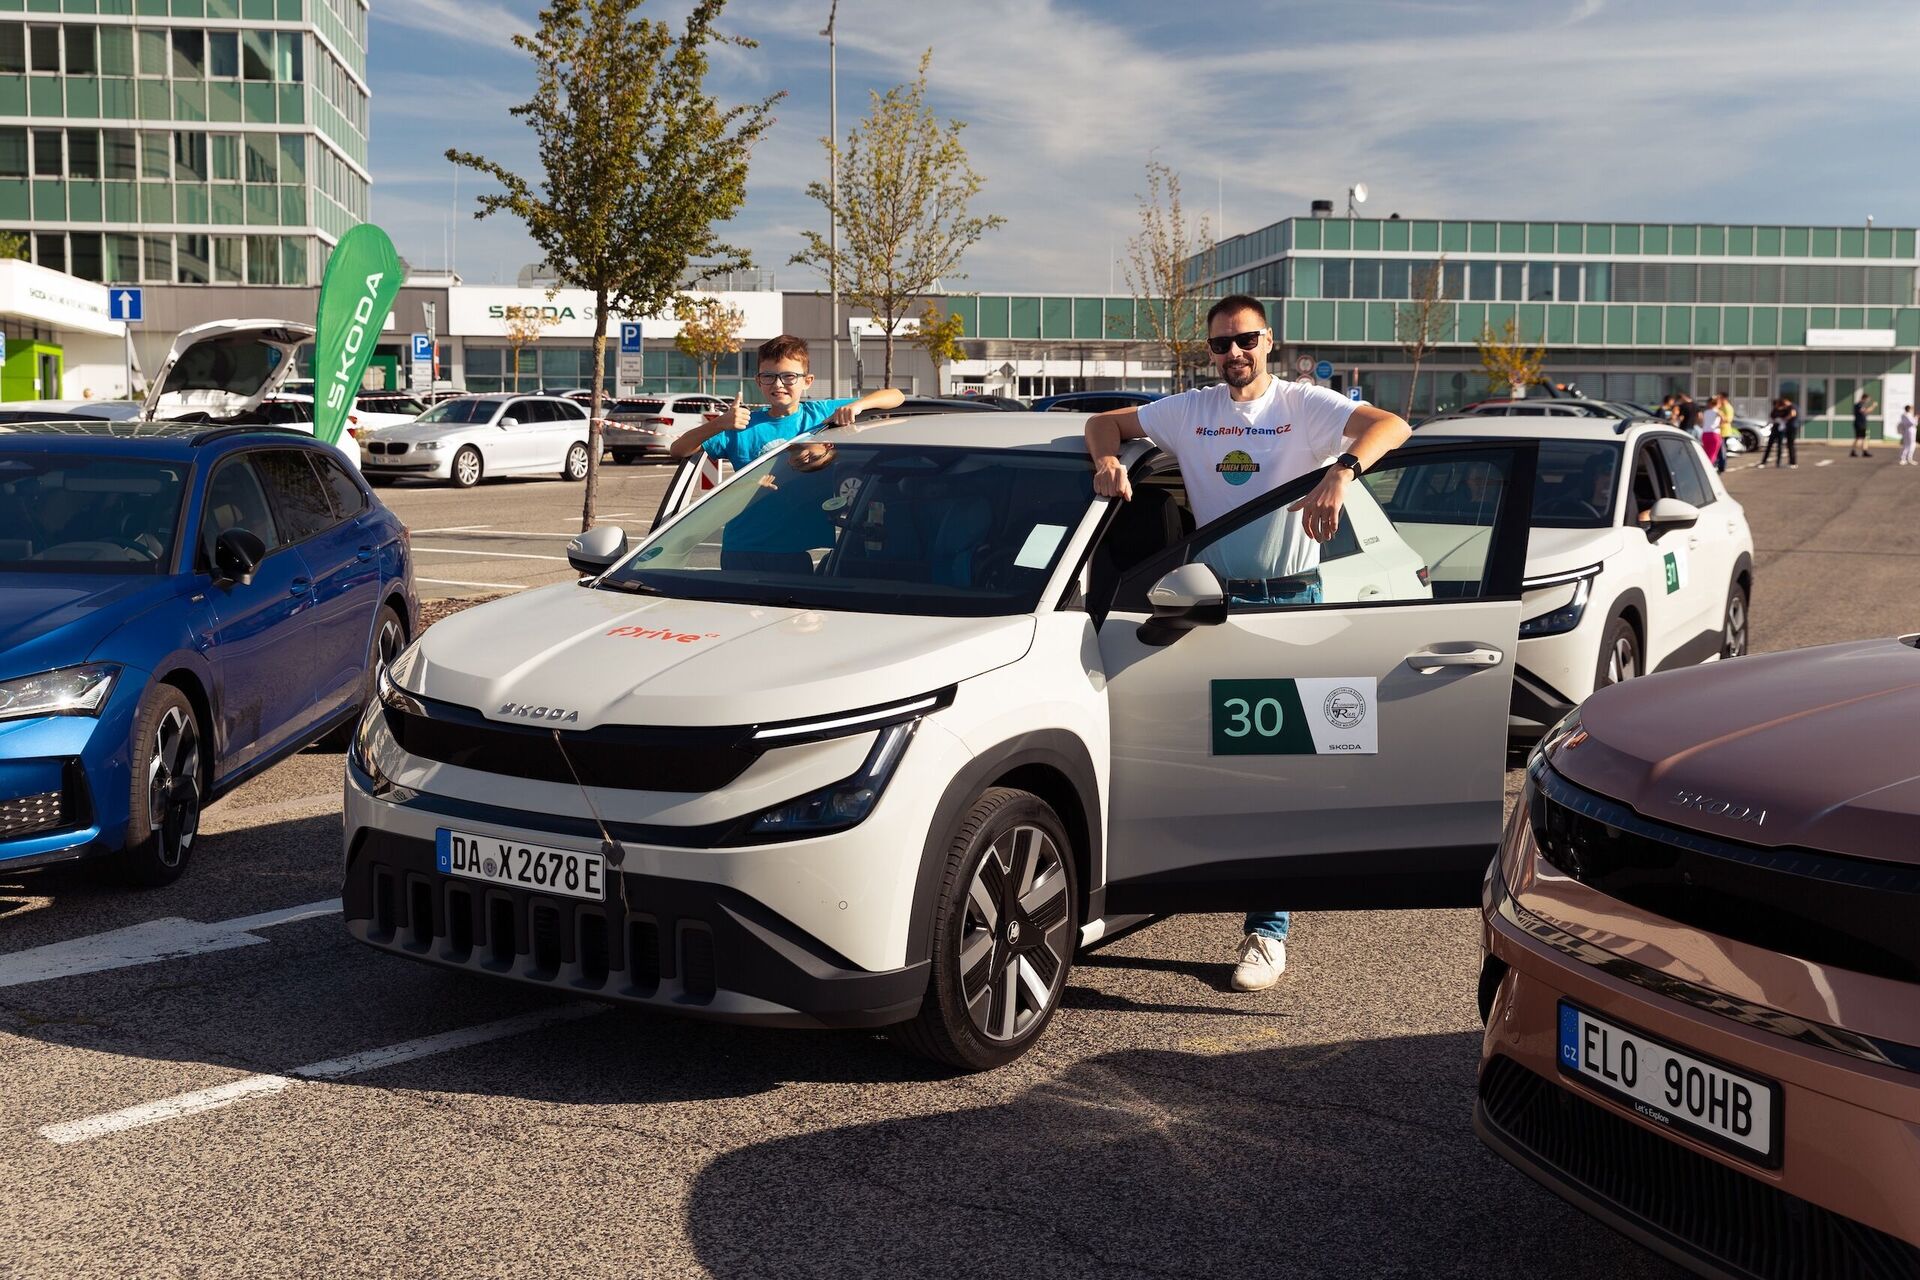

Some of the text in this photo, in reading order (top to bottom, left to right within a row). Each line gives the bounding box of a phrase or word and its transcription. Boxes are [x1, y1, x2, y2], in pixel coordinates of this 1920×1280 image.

[416, 337, 429, 354] P
[624, 326, 638, 345] P
[1350, 389, 1359, 401] P
[1666, 562, 1677, 586] 31
[1223, 697, 1283, 738] 30
[441, 855, 448, 866] D
[452, 836, 481, 874] DA
[1563, 1044, 1578, 1062] CZ
[1664, 1057, 1752, 1137] 90HB
[1634, 1101, 1670, 1124] Let's Explore
